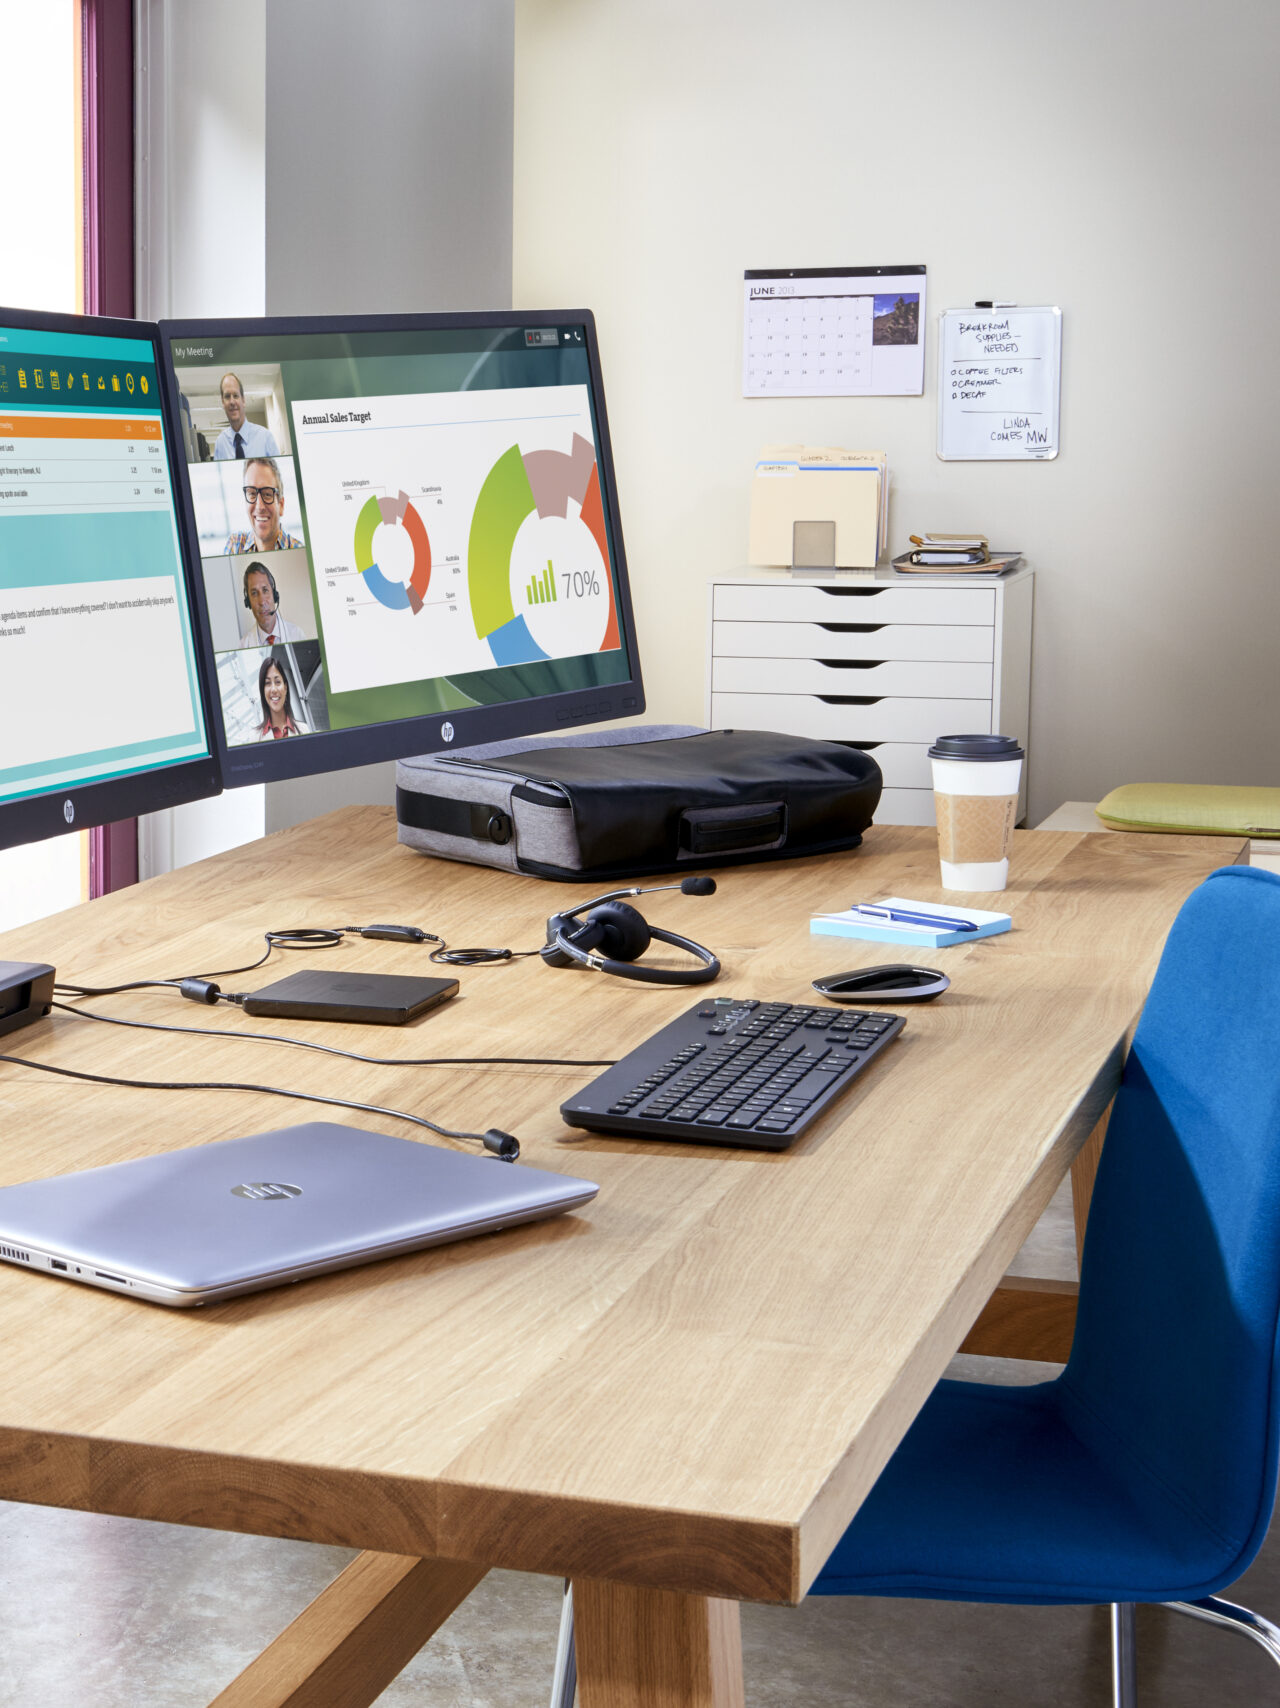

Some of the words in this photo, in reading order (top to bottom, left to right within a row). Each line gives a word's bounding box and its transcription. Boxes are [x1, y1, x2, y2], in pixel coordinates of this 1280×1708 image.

[750, 287, 775, 296] JUNE
[778, 286, 795, 295] 2013
[175, 347, 186, 358] My
[186, 346, 213, 358] Meeting
[984, 342, 1019, 353] NEEDED
[961, 390, 987, 400] DECAF
[302, 412, 329, 425] Annual
[330, 411, 348, 423] Sales
[349, 410, 372, 424] Target
[1003, 416, 1030, 430] LINDA
[1026, 427, 1048, 444] MW
[562, 569, 600, 600] 70%
[1, 611, 17, 623] agenda
[28, 608, 36, 617] and
[441, 721, 454, 743] hp
[63, 799, 75, 824] hp
[231, 1182, 303, 1200] hp
